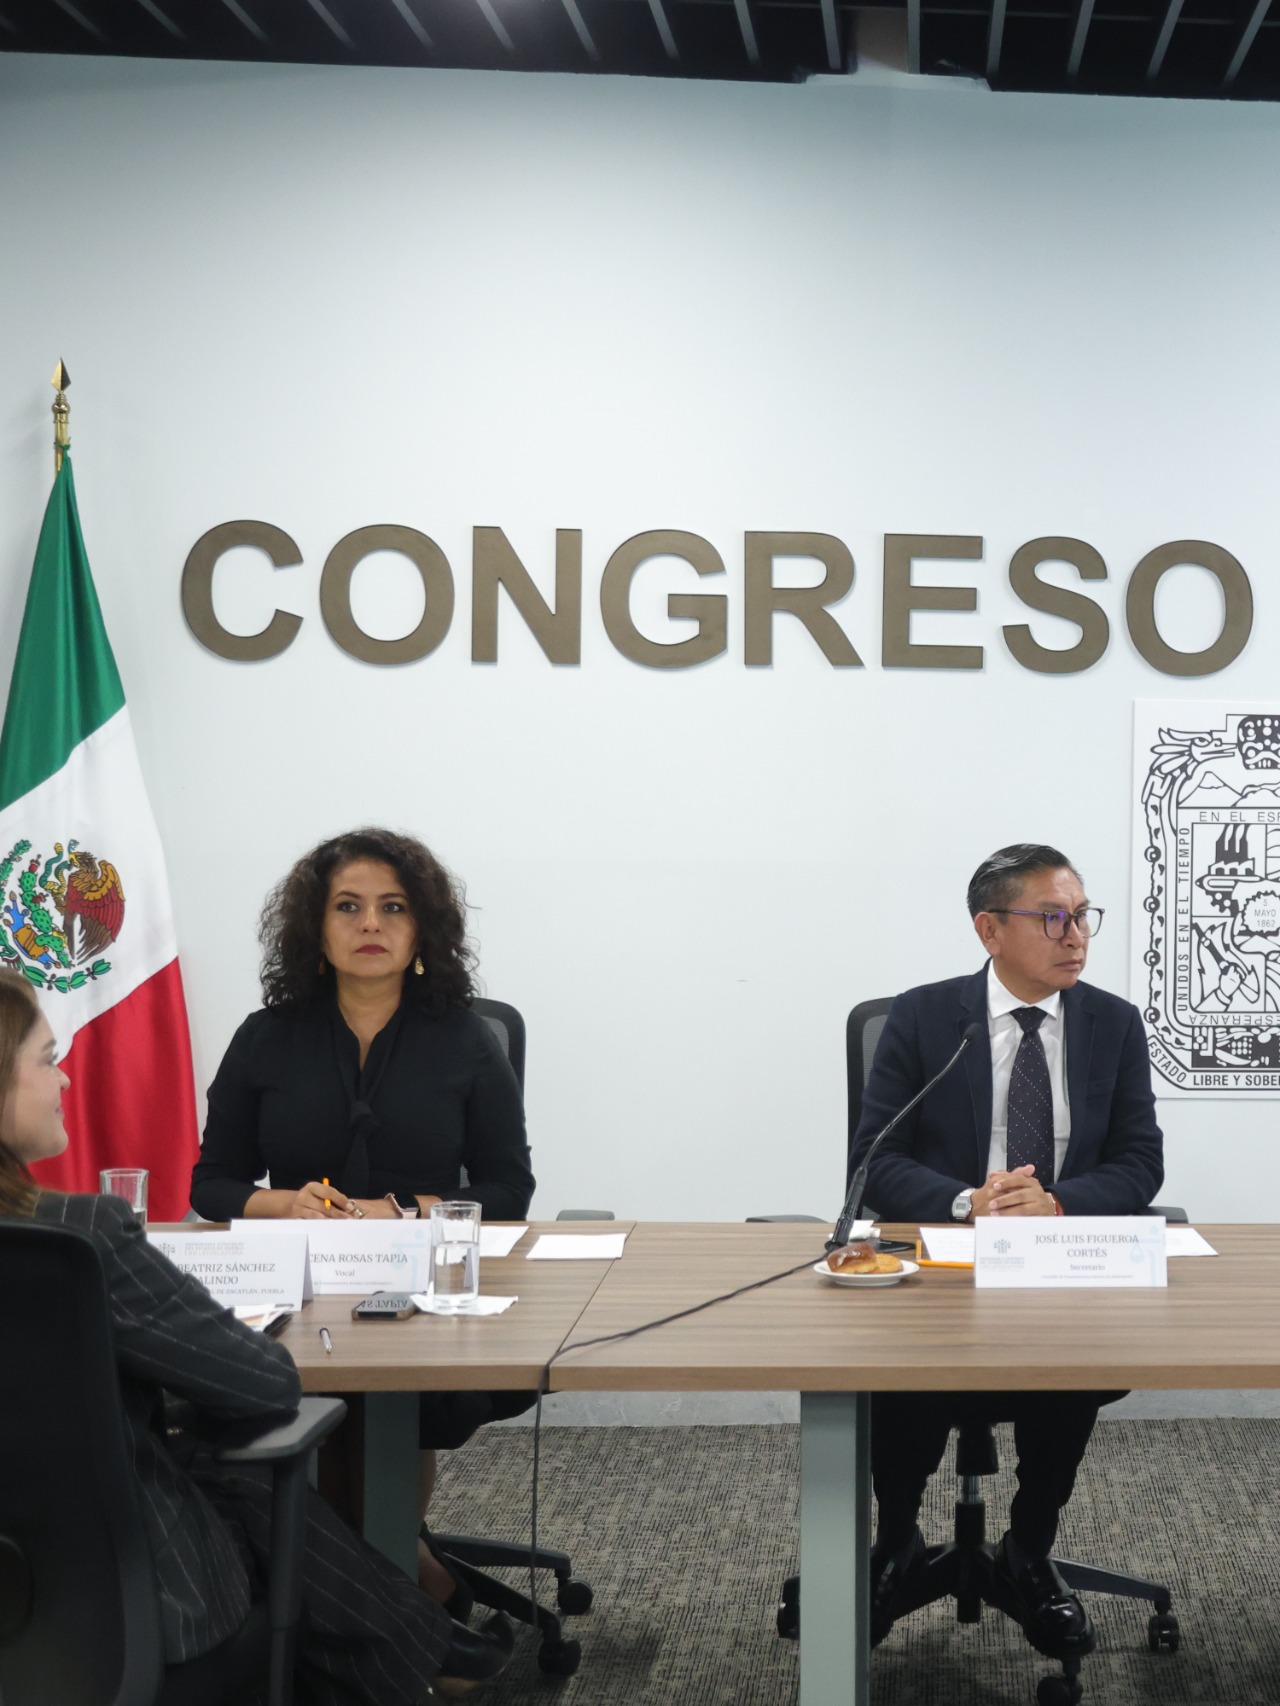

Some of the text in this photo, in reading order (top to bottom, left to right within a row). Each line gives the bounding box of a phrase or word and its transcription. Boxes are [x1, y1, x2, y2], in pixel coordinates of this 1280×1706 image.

[180, 519, 1255, 678] CONGRESO
[1199, 811, 1220, 823] EN
[1230, 811, 1246, 823] EL
[1263, 898, 1268, 907] 5
[1254, 909, 1277, 917] MAYO
[1178, 827, 1190, 1012] UNIDOS EN EL TIEMPO
[1257, 919, 1276, 928] 1862
[1148, 1041, 1188, 1084] ESTADO
[1192, 1074, 1229, 1086] LIBRE
[1233, 1074, 1242, 1086] Y
[1035, 1233, 1139, 1245] JOSÉ LUIS FIGUEROA
[339, 1253, 373, 1263] ROSAS
[375, 1253, 408, 1263] TAPIA
[1067, 1247, 1108, 1258] CORTÉS
[177, 1261, 276, 1273] BEATRIZ SÁNCHEZ
[1069, 1263, 1106, 1271] Secretario
[335, 1269, 355, 1277] Vocal
